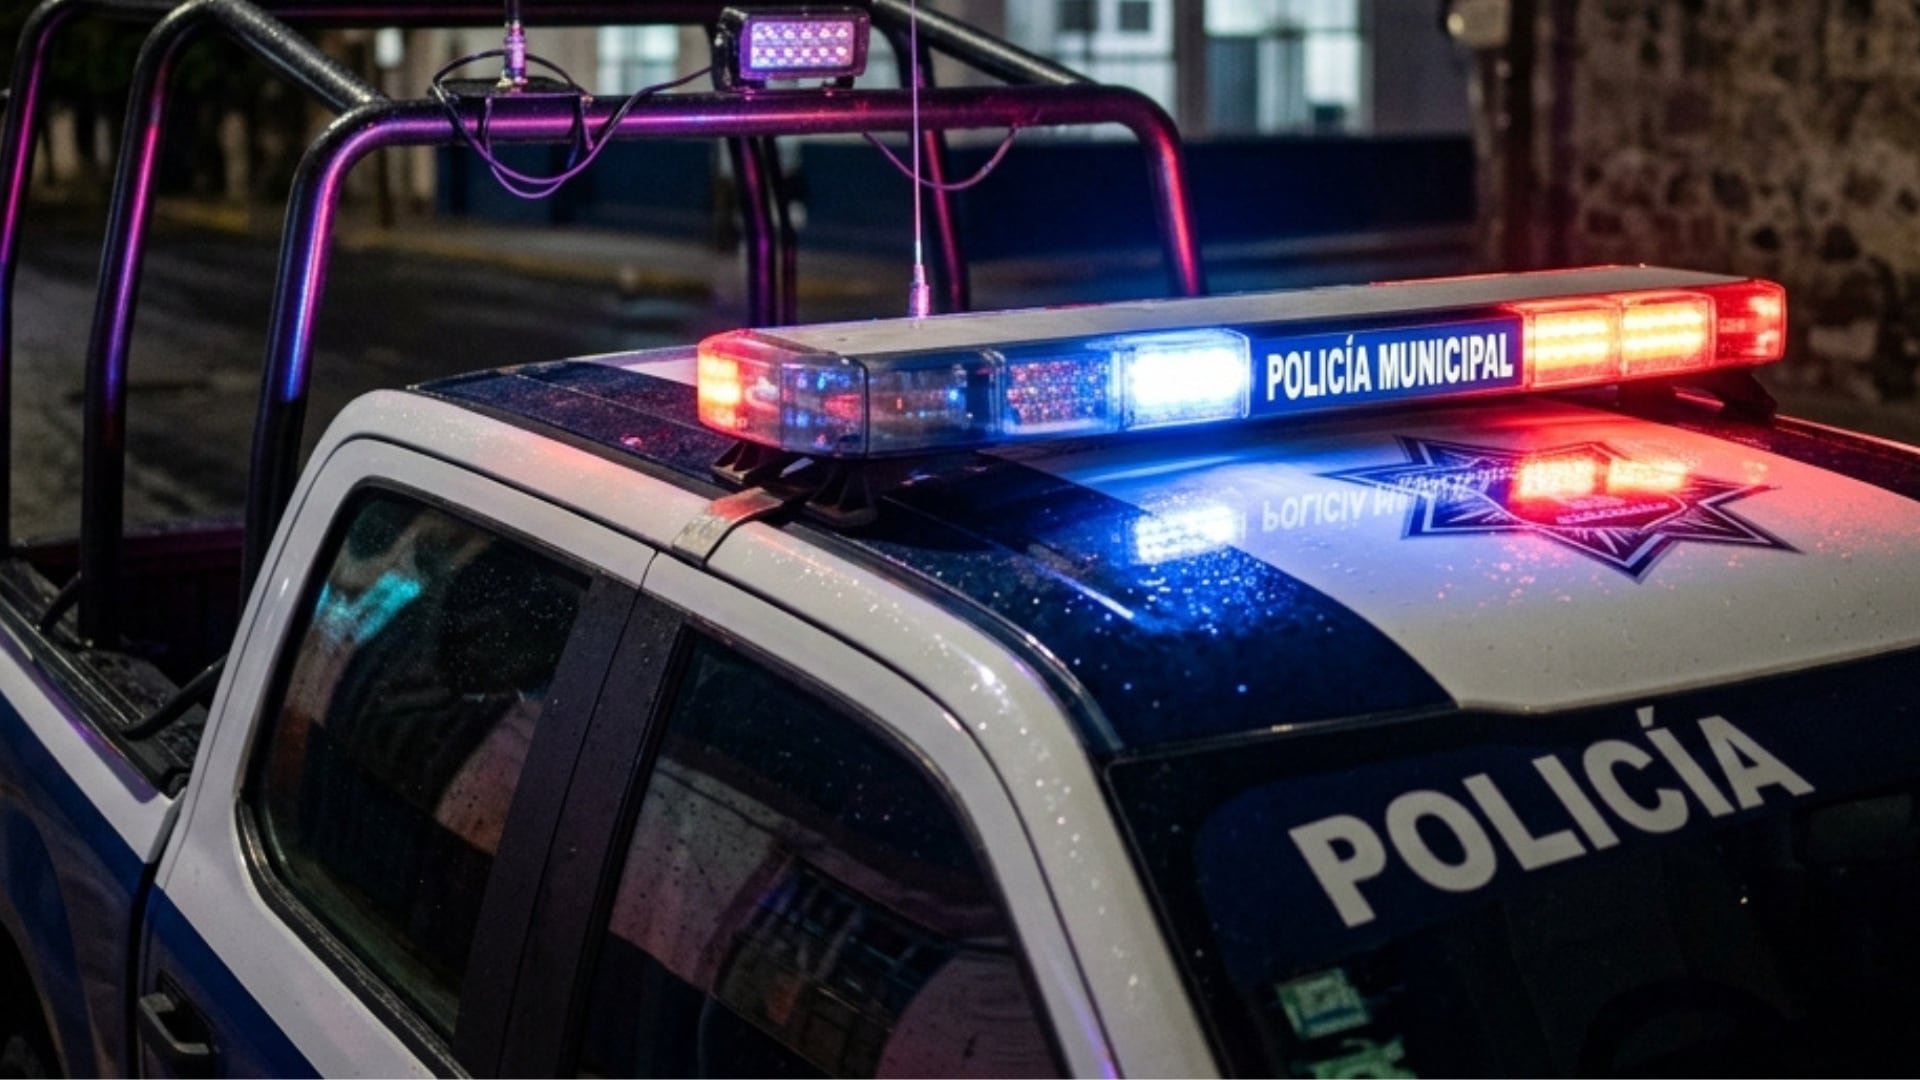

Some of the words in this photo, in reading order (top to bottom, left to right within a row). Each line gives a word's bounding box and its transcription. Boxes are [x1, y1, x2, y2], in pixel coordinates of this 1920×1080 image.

[1267, 334, 1372, 401] POLICÍA
[1378, 333, 1514, 391] MUNICIPAL
[1289, 705, 1815, 928] POLICÍA
